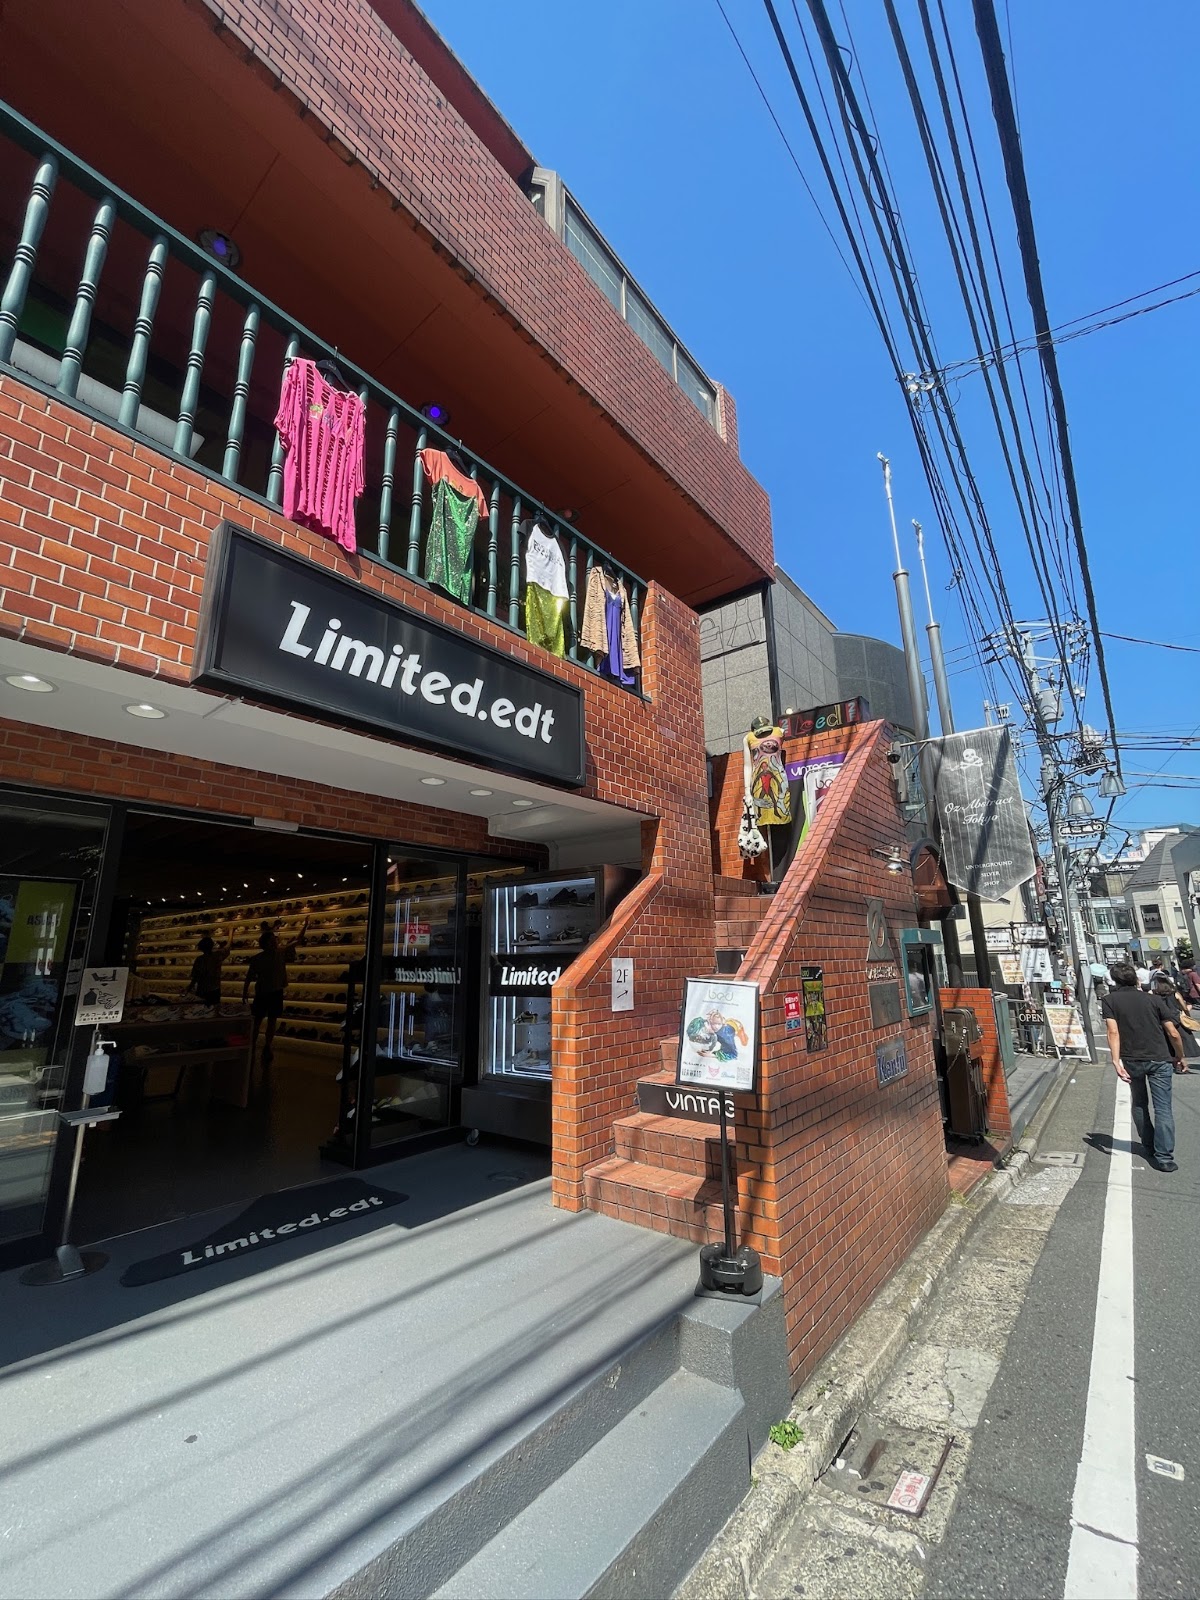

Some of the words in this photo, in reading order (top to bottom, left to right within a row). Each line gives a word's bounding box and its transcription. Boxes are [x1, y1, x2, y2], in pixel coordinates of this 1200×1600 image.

[279, 601, 555, 743] Limited.edt
[961, 796, 1014, 812] Abstract
[962, 814, 998, 826] Tokyo
[965, 860, 1013, 870] UNDERGROUND
[501, 966, 561, 986] Limited
[616, 969, 629, 983] 2F
[708, 989, 734, 1002] bed
[1019, 1013, 1044, 1022] OPEN
[181, 1196, 384, 1266] Limited.edt
